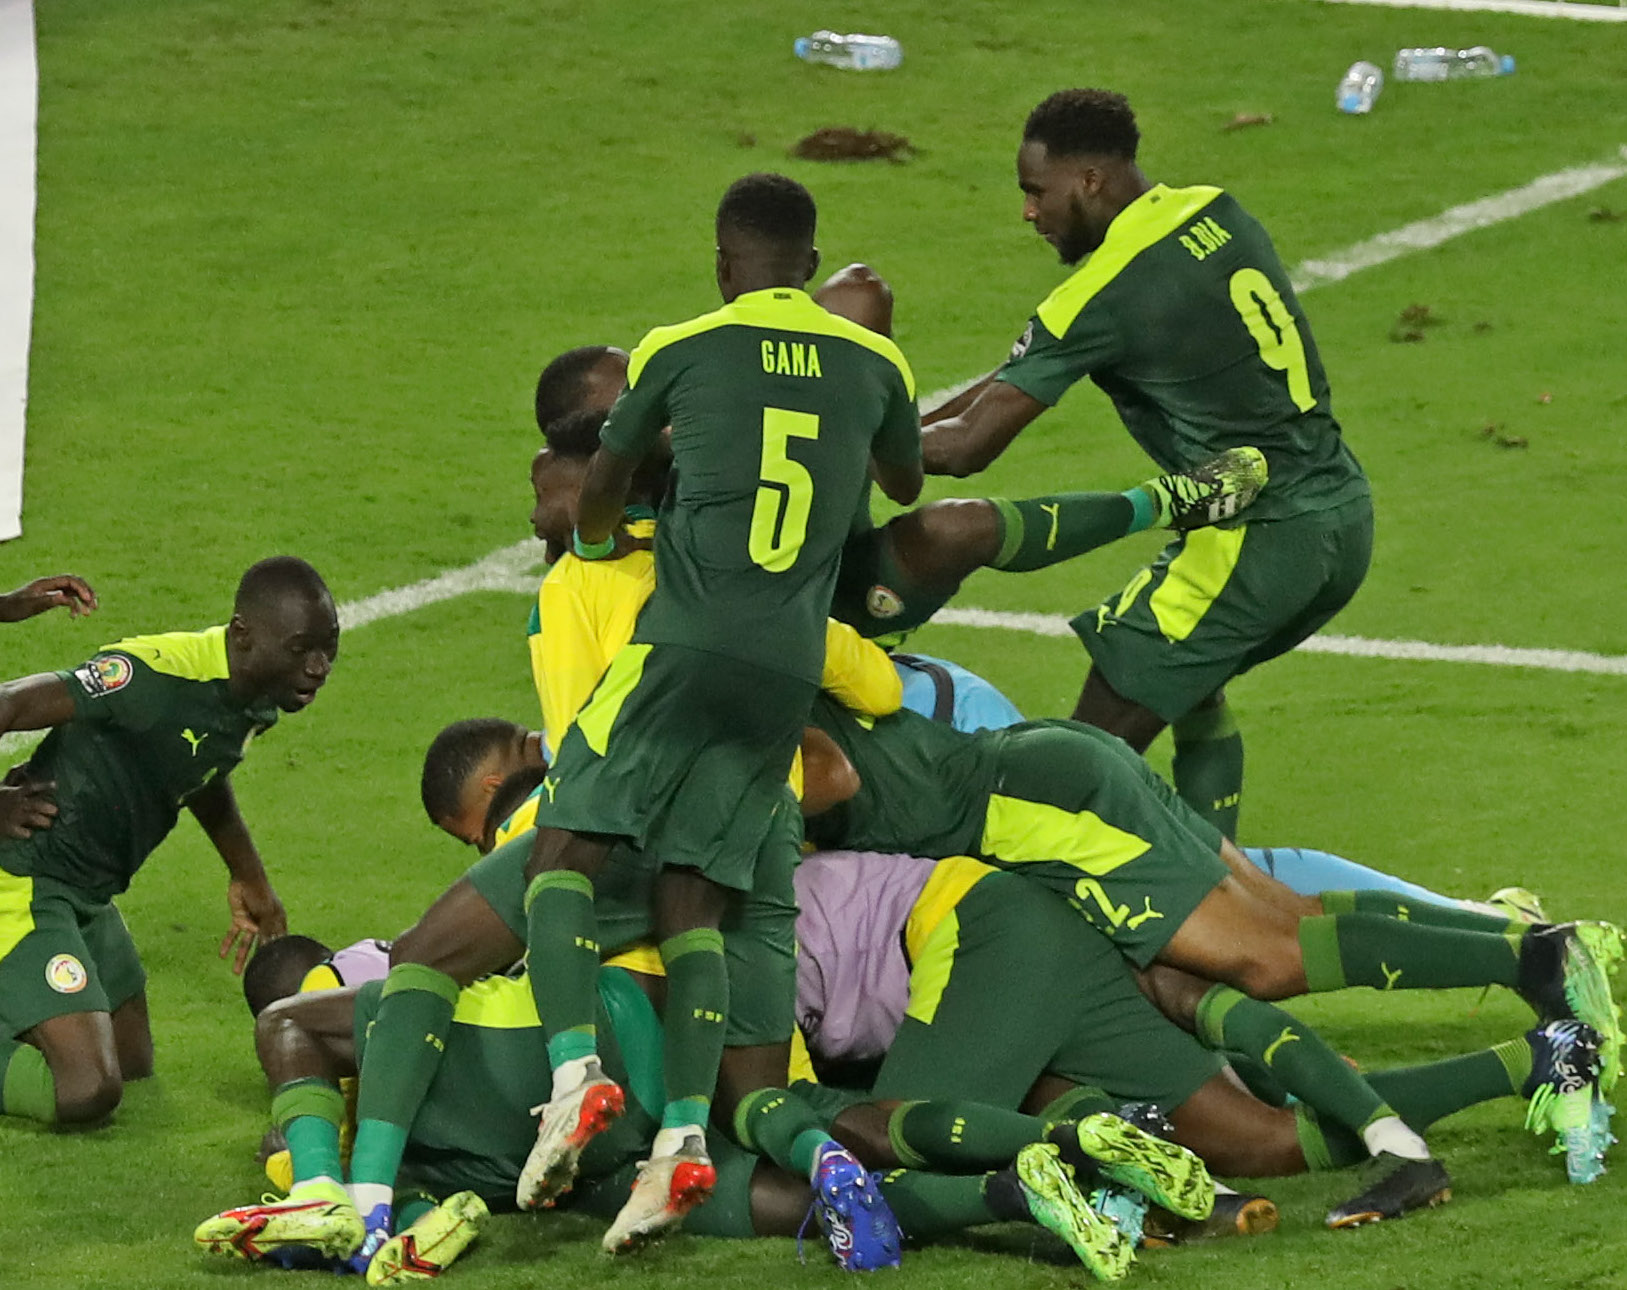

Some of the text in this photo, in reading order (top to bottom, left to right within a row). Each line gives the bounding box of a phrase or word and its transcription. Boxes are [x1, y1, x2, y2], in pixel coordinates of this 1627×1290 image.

[761, 340, 823, 378] GANA
[1229, 268, 1318, 414] 9
[748, 406, 820, 573] 5
